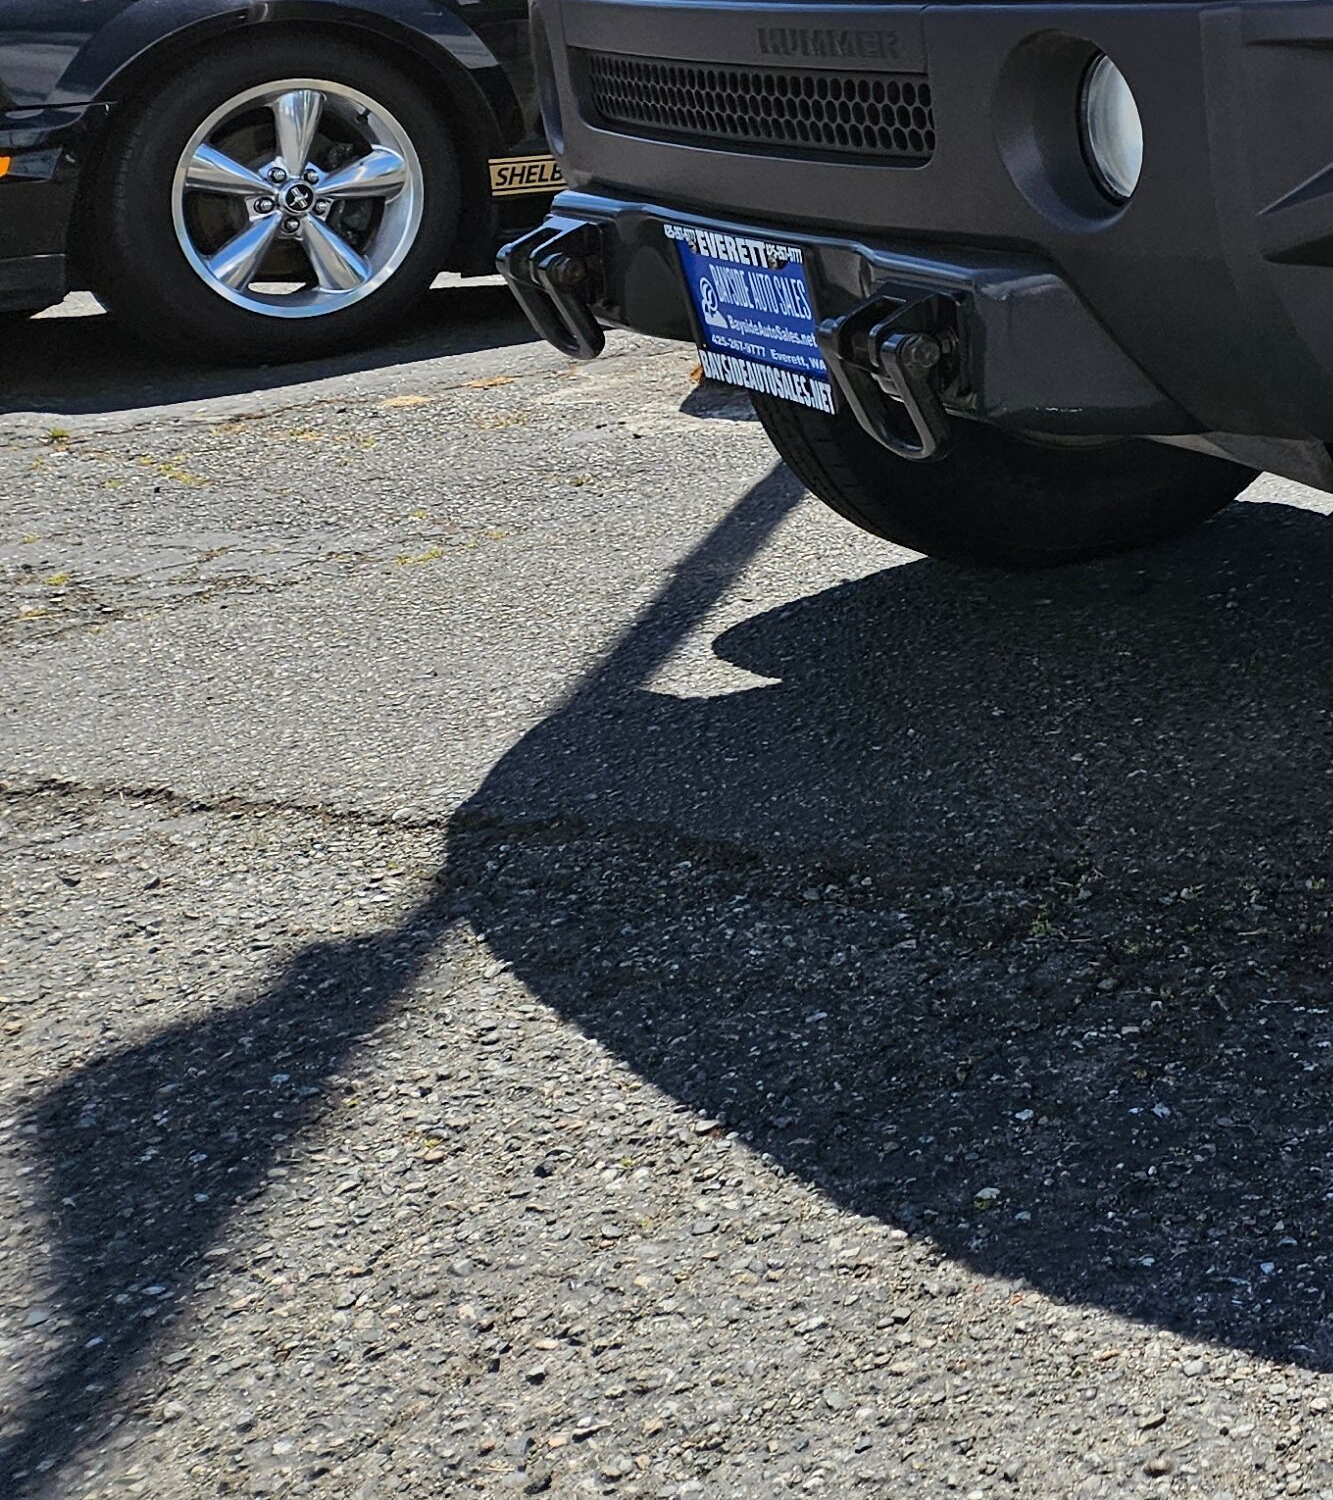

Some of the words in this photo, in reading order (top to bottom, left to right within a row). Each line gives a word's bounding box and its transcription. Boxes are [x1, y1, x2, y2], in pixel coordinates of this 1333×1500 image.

[757, 27, 900, 59] HUMMER
[695, 229, 769, 269] EVERETT
[709, 264, 754, 309] BAYSIDE
[748, 271, 780, 314] AUTO
[773, 275, 812, 320] SALES
[727, 314, 818, 348] BaysideAutoSales.net
[700, 350, 836, 415] BAYSIDEAUTOSALES.NET
[808, 357, 828, 371] WA
